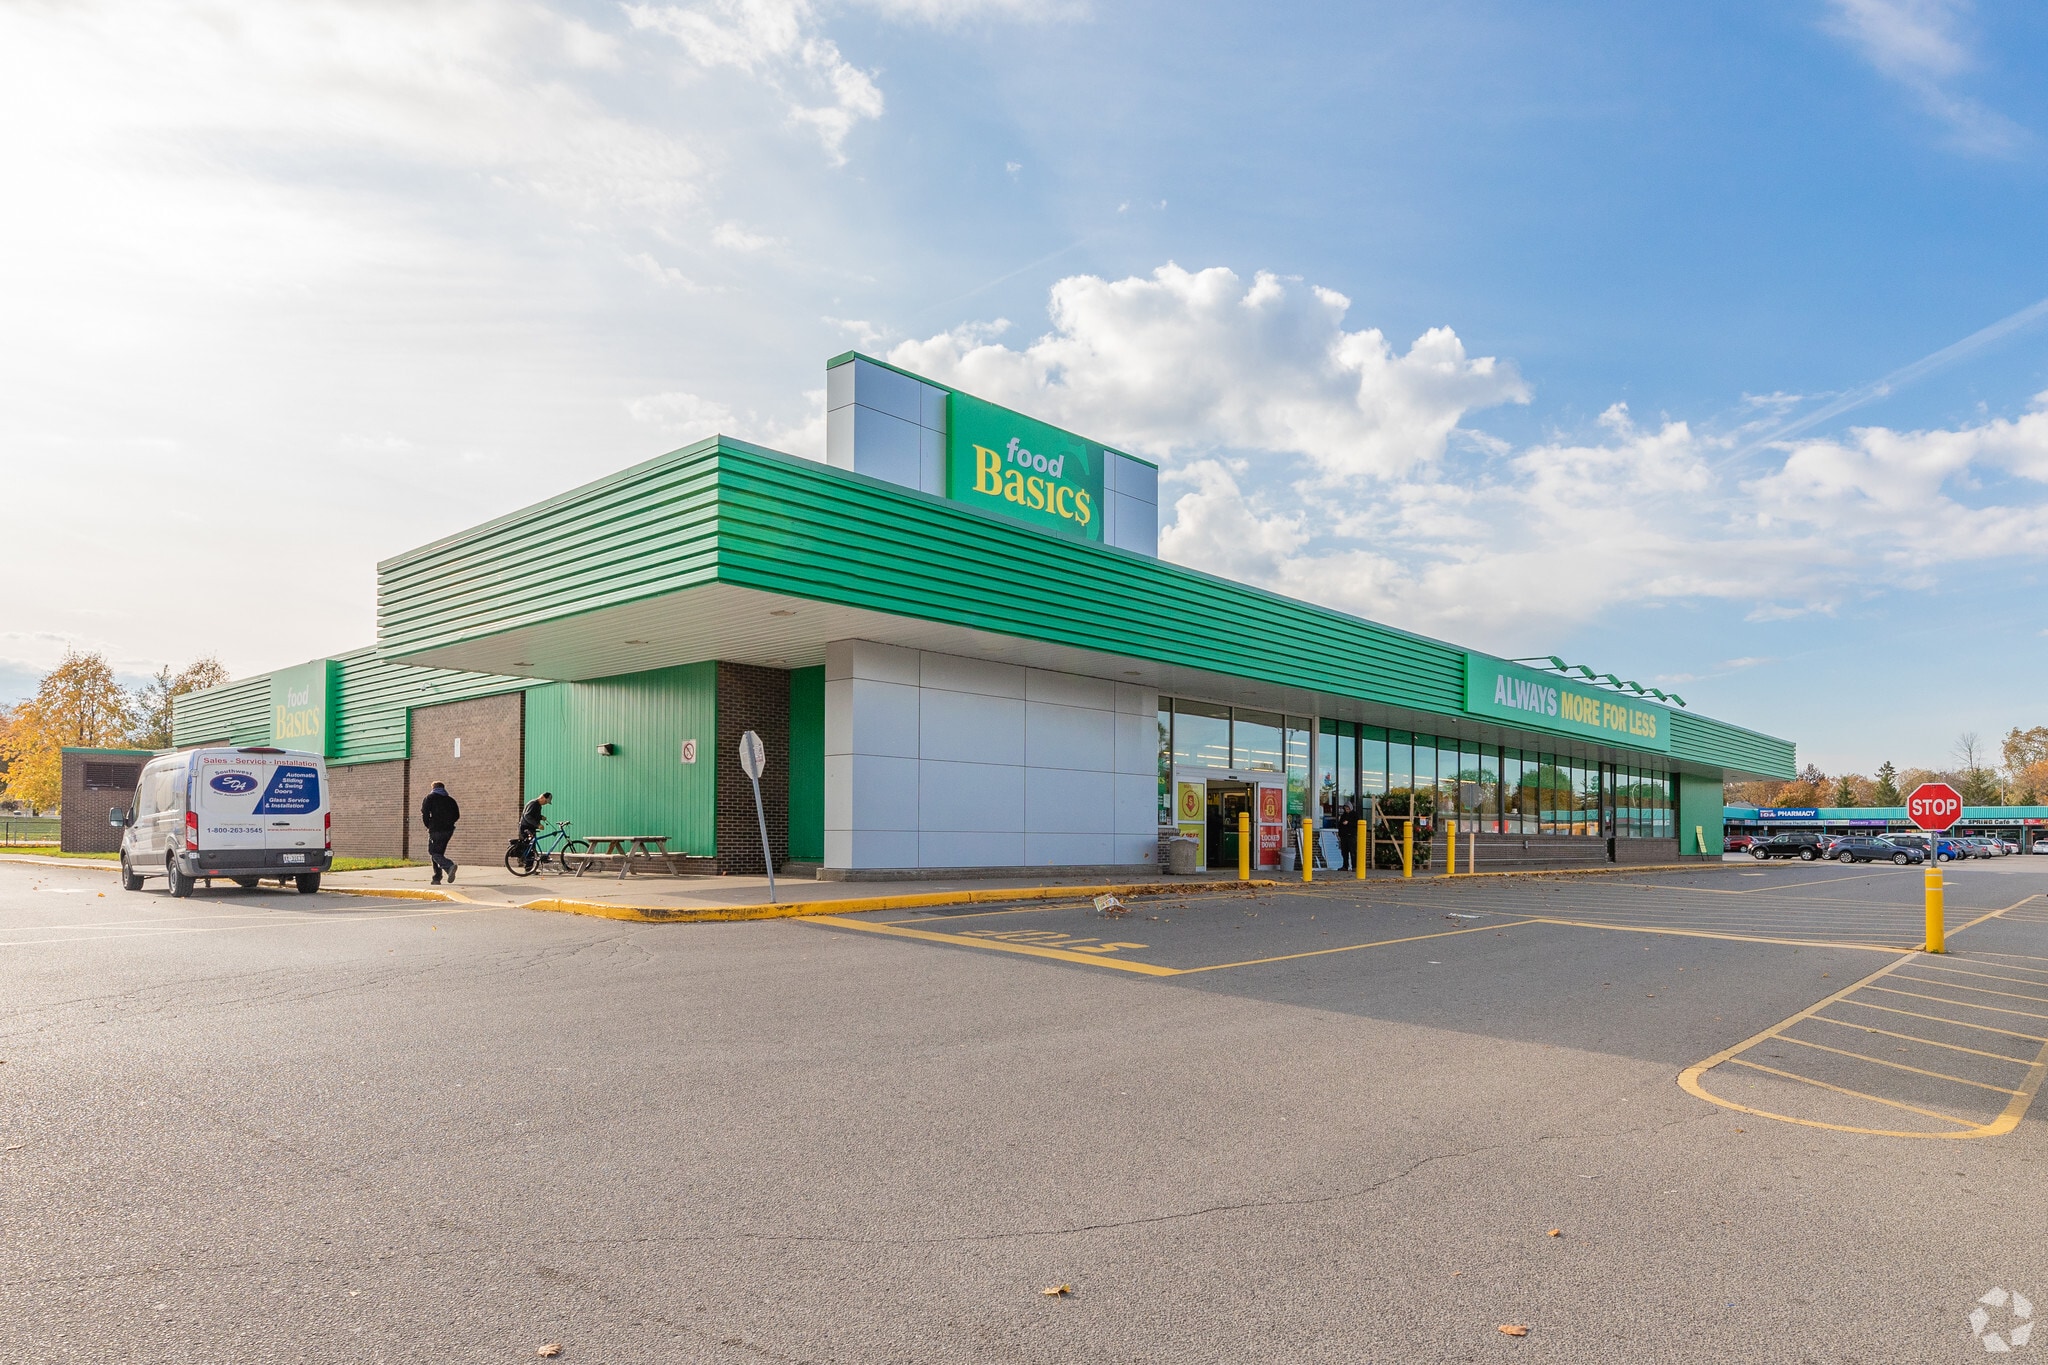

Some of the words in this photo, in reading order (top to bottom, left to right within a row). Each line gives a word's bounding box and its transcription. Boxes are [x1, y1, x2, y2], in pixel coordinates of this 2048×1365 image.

[1006, 436, 1065, 478] food
[287, 684, 310, 708] food
[1494, 674, 1558, 717] ALWAYS
[1561, 691, 1601, 727] MORE
[1603, 703, 1627, 733] FOR
[1629, 709, 1657, 739] LESS
[274, 759, 318, 767] Installation
[222, 776, 247, 791] SDA
[1911, 798, 1958, 816] STOP
